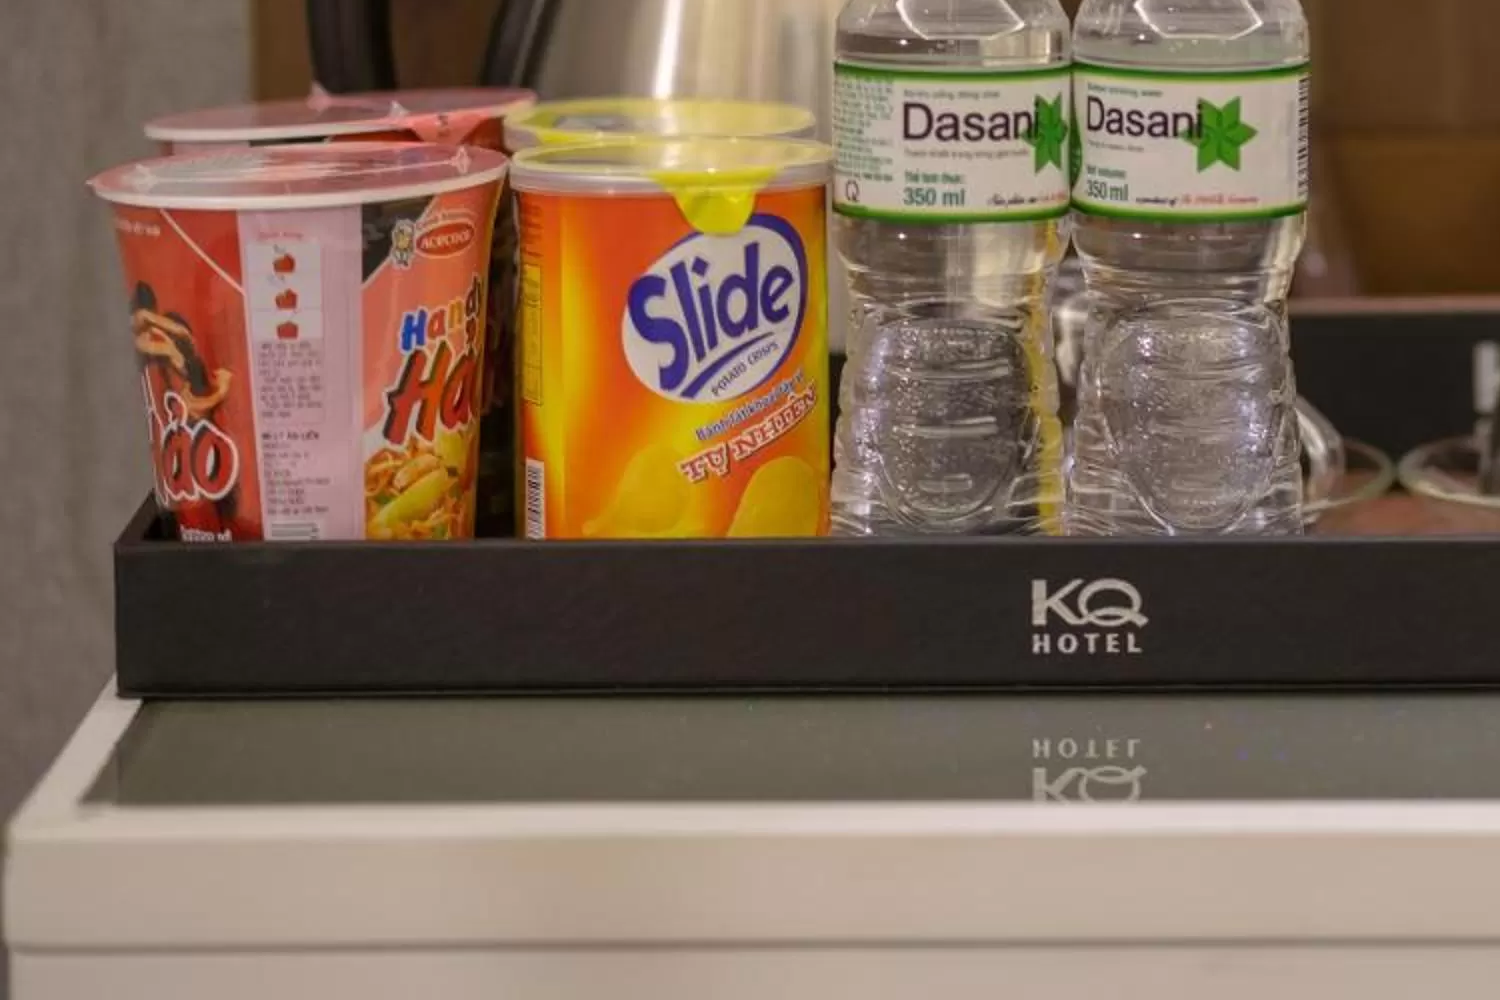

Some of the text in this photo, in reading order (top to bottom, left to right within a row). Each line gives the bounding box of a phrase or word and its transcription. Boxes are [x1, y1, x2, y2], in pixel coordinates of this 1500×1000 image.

[903, 101, 1041, 142] Dasani
[1086, 94, 1203, 138] Dasani
[903, 186, 937, 206] 350
[941, 187, 966, 206] ml
[1086, 179, 1107, 201] 350
[1109, 183, 1129, 201] ml
[627, 241, 793, 391] Slide
[710, 341, 779, 396] POTATO CRISPS
[1032, 578, 1149, 628] KQ
[1032, 632, 1143, 654] HOTEL
